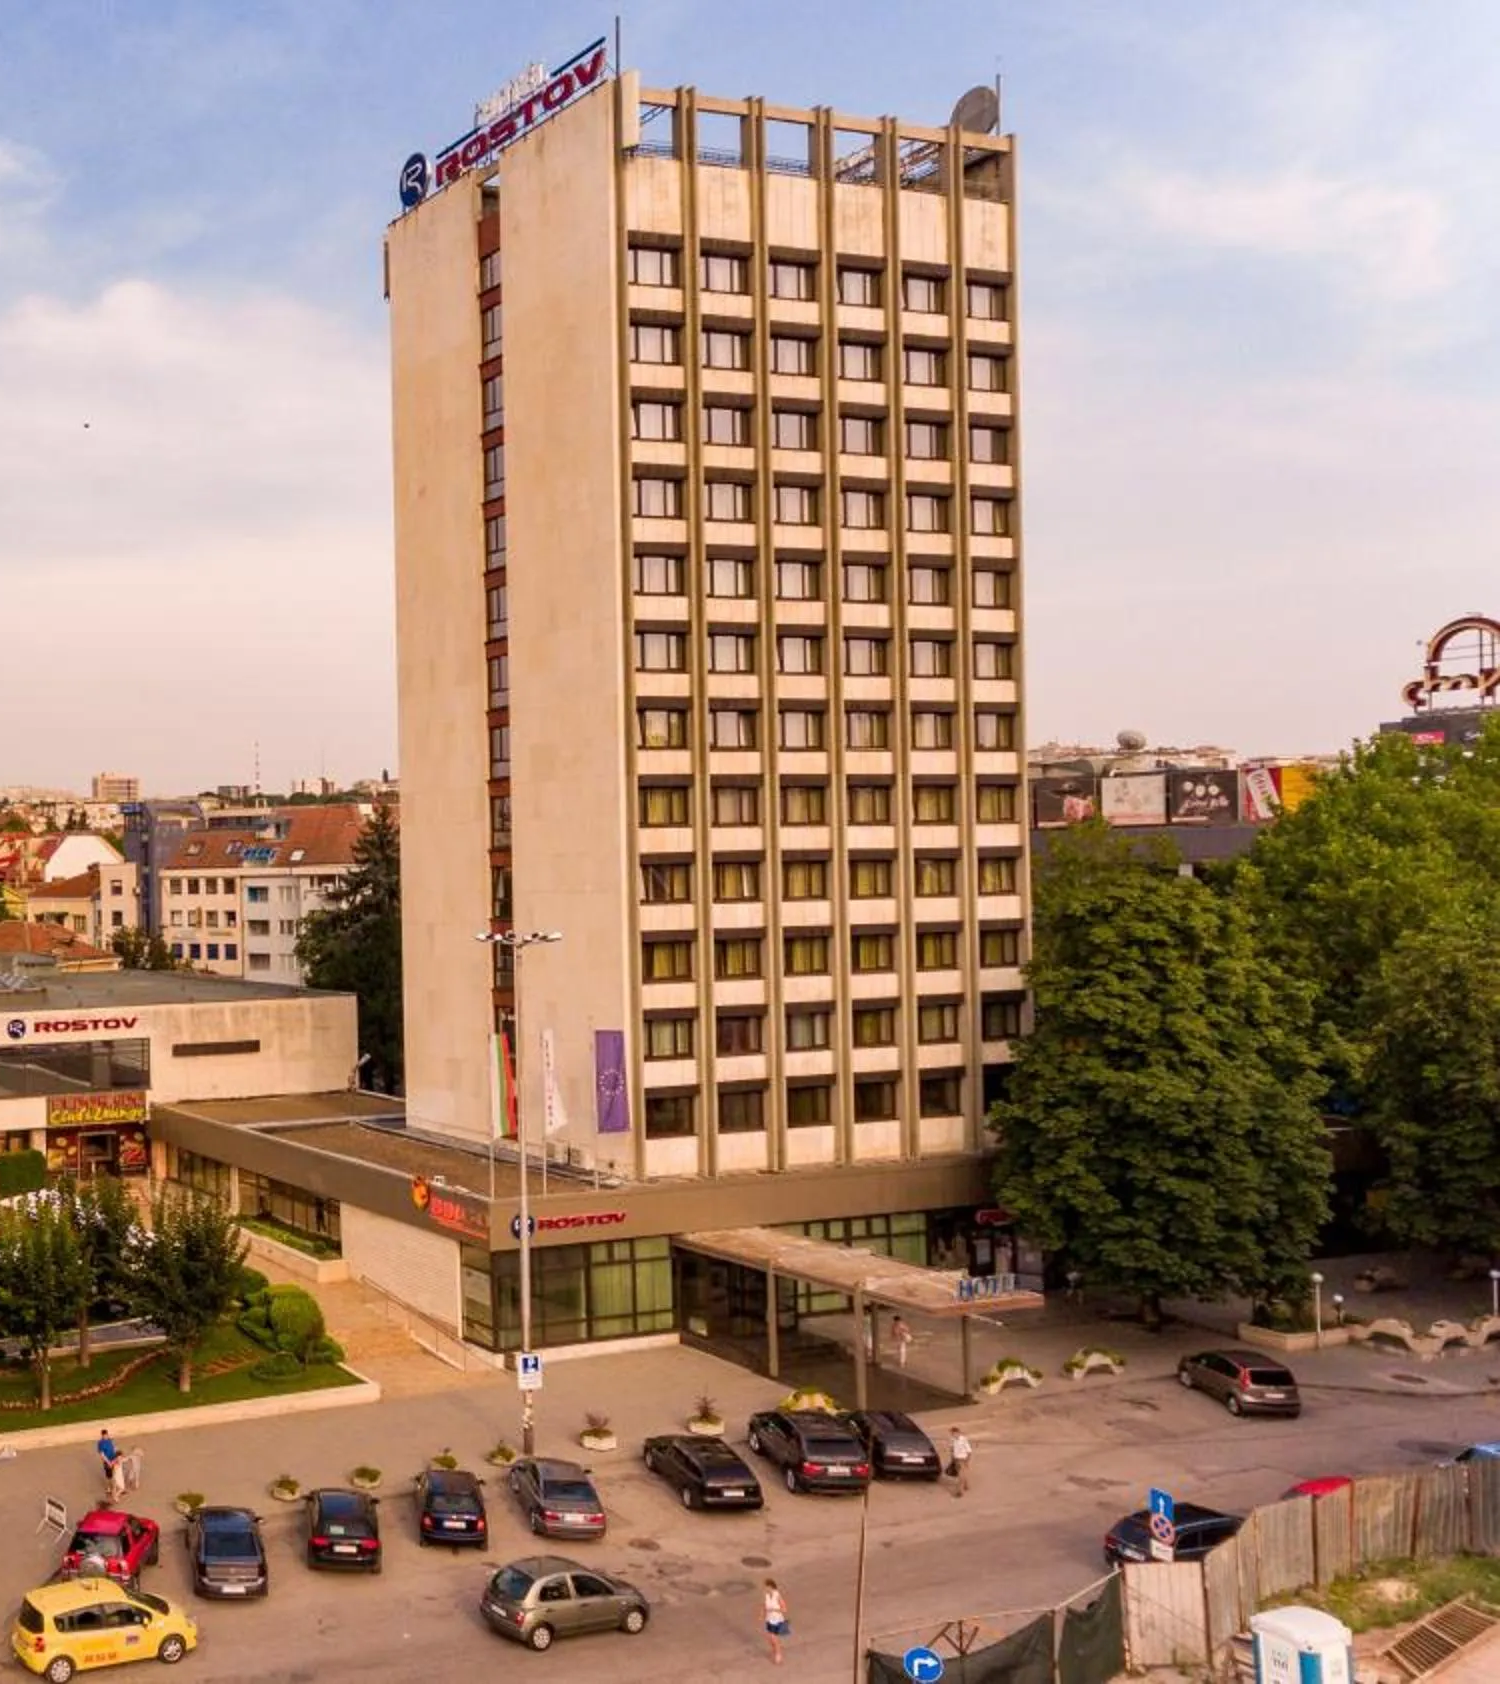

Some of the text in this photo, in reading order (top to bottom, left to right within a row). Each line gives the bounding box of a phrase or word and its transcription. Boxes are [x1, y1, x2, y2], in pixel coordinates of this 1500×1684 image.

[436, 48, 606, 187] ROSTOV
[34, 1017, 138, 1033] ROSTOV
[537, 1212, 626, 1230] ROSTOV
